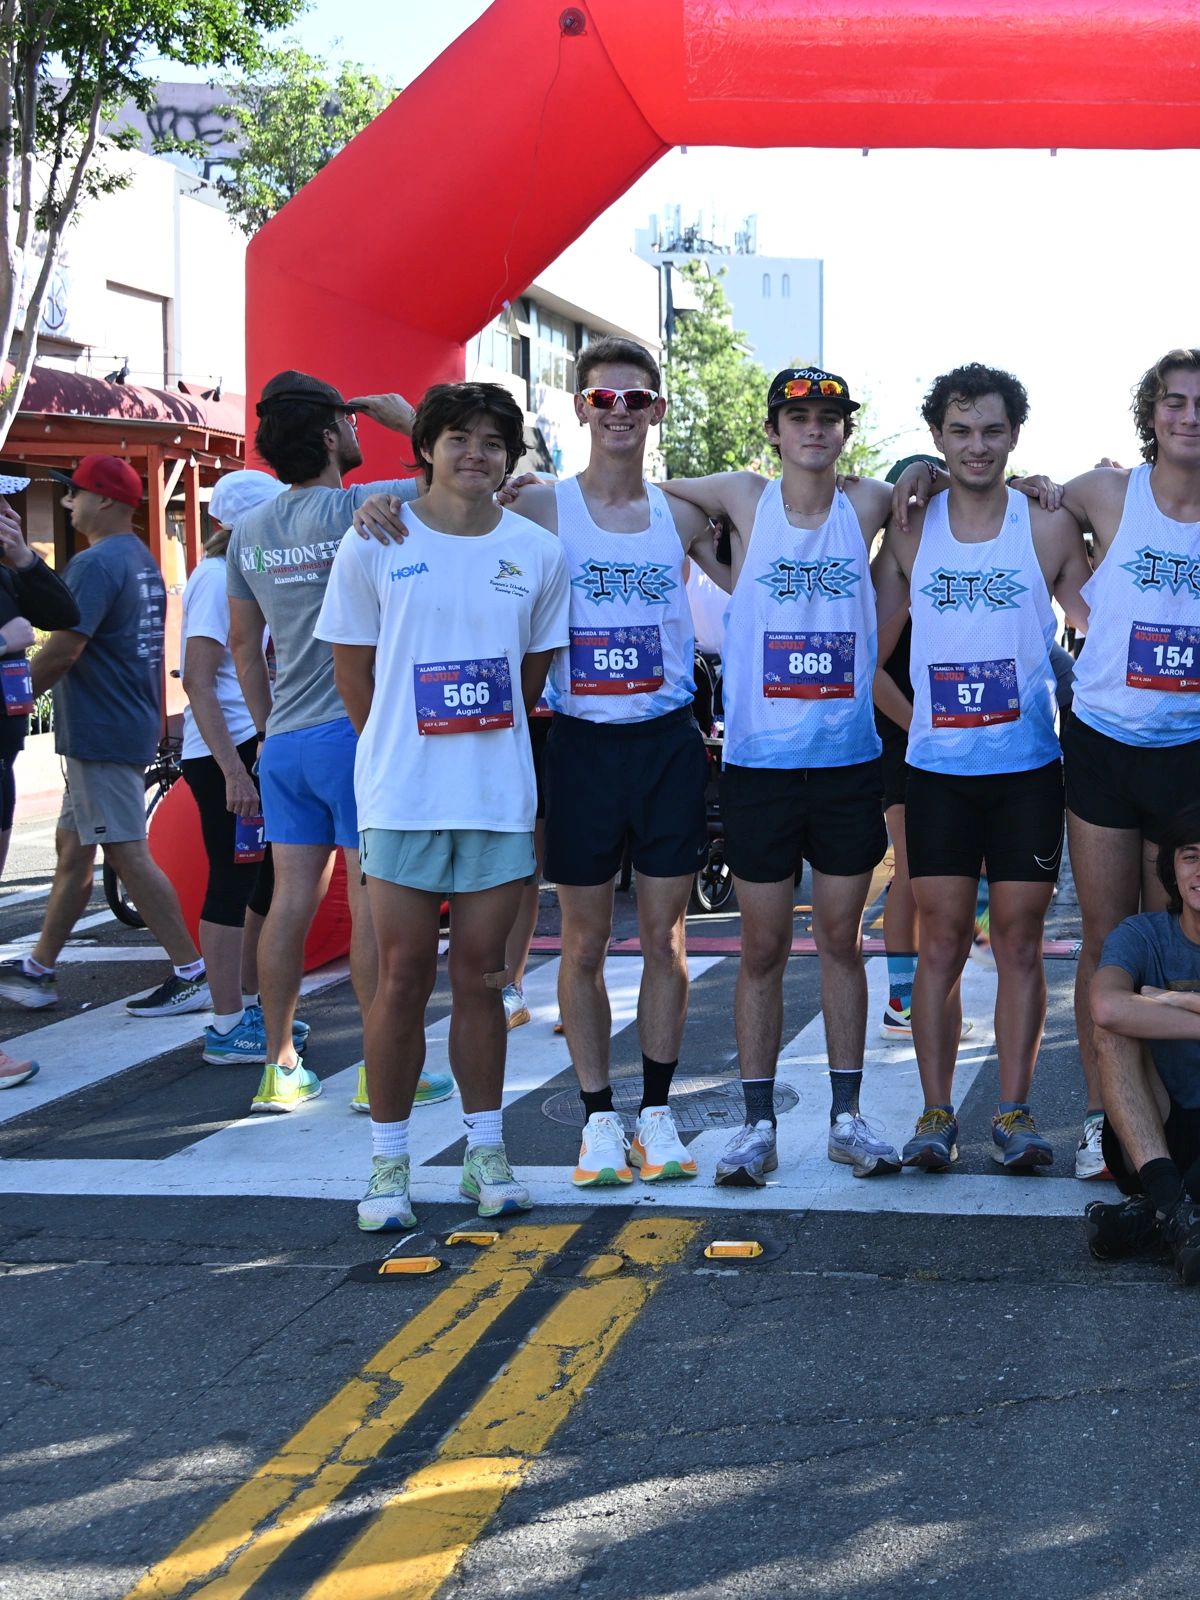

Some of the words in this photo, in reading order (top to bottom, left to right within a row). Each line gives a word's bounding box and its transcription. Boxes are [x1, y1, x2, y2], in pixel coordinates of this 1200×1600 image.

[307, 572, 319, 580] CA
[391, 562, 429, 582] HOKA
[593, 647, 639, 670] 563
[788, 652, 832, 674] 868
[1153, 644, 1194, 668] 154
[1159, 668, 1185, 676] AARON
[443, 681, 490, 707] 566
[957, 682, 985, 705] 57
[456, 707, 481, 716] August
[170, 984, 201, 1005] HOKA
[233, 1039, 261, 1050] HOKA
